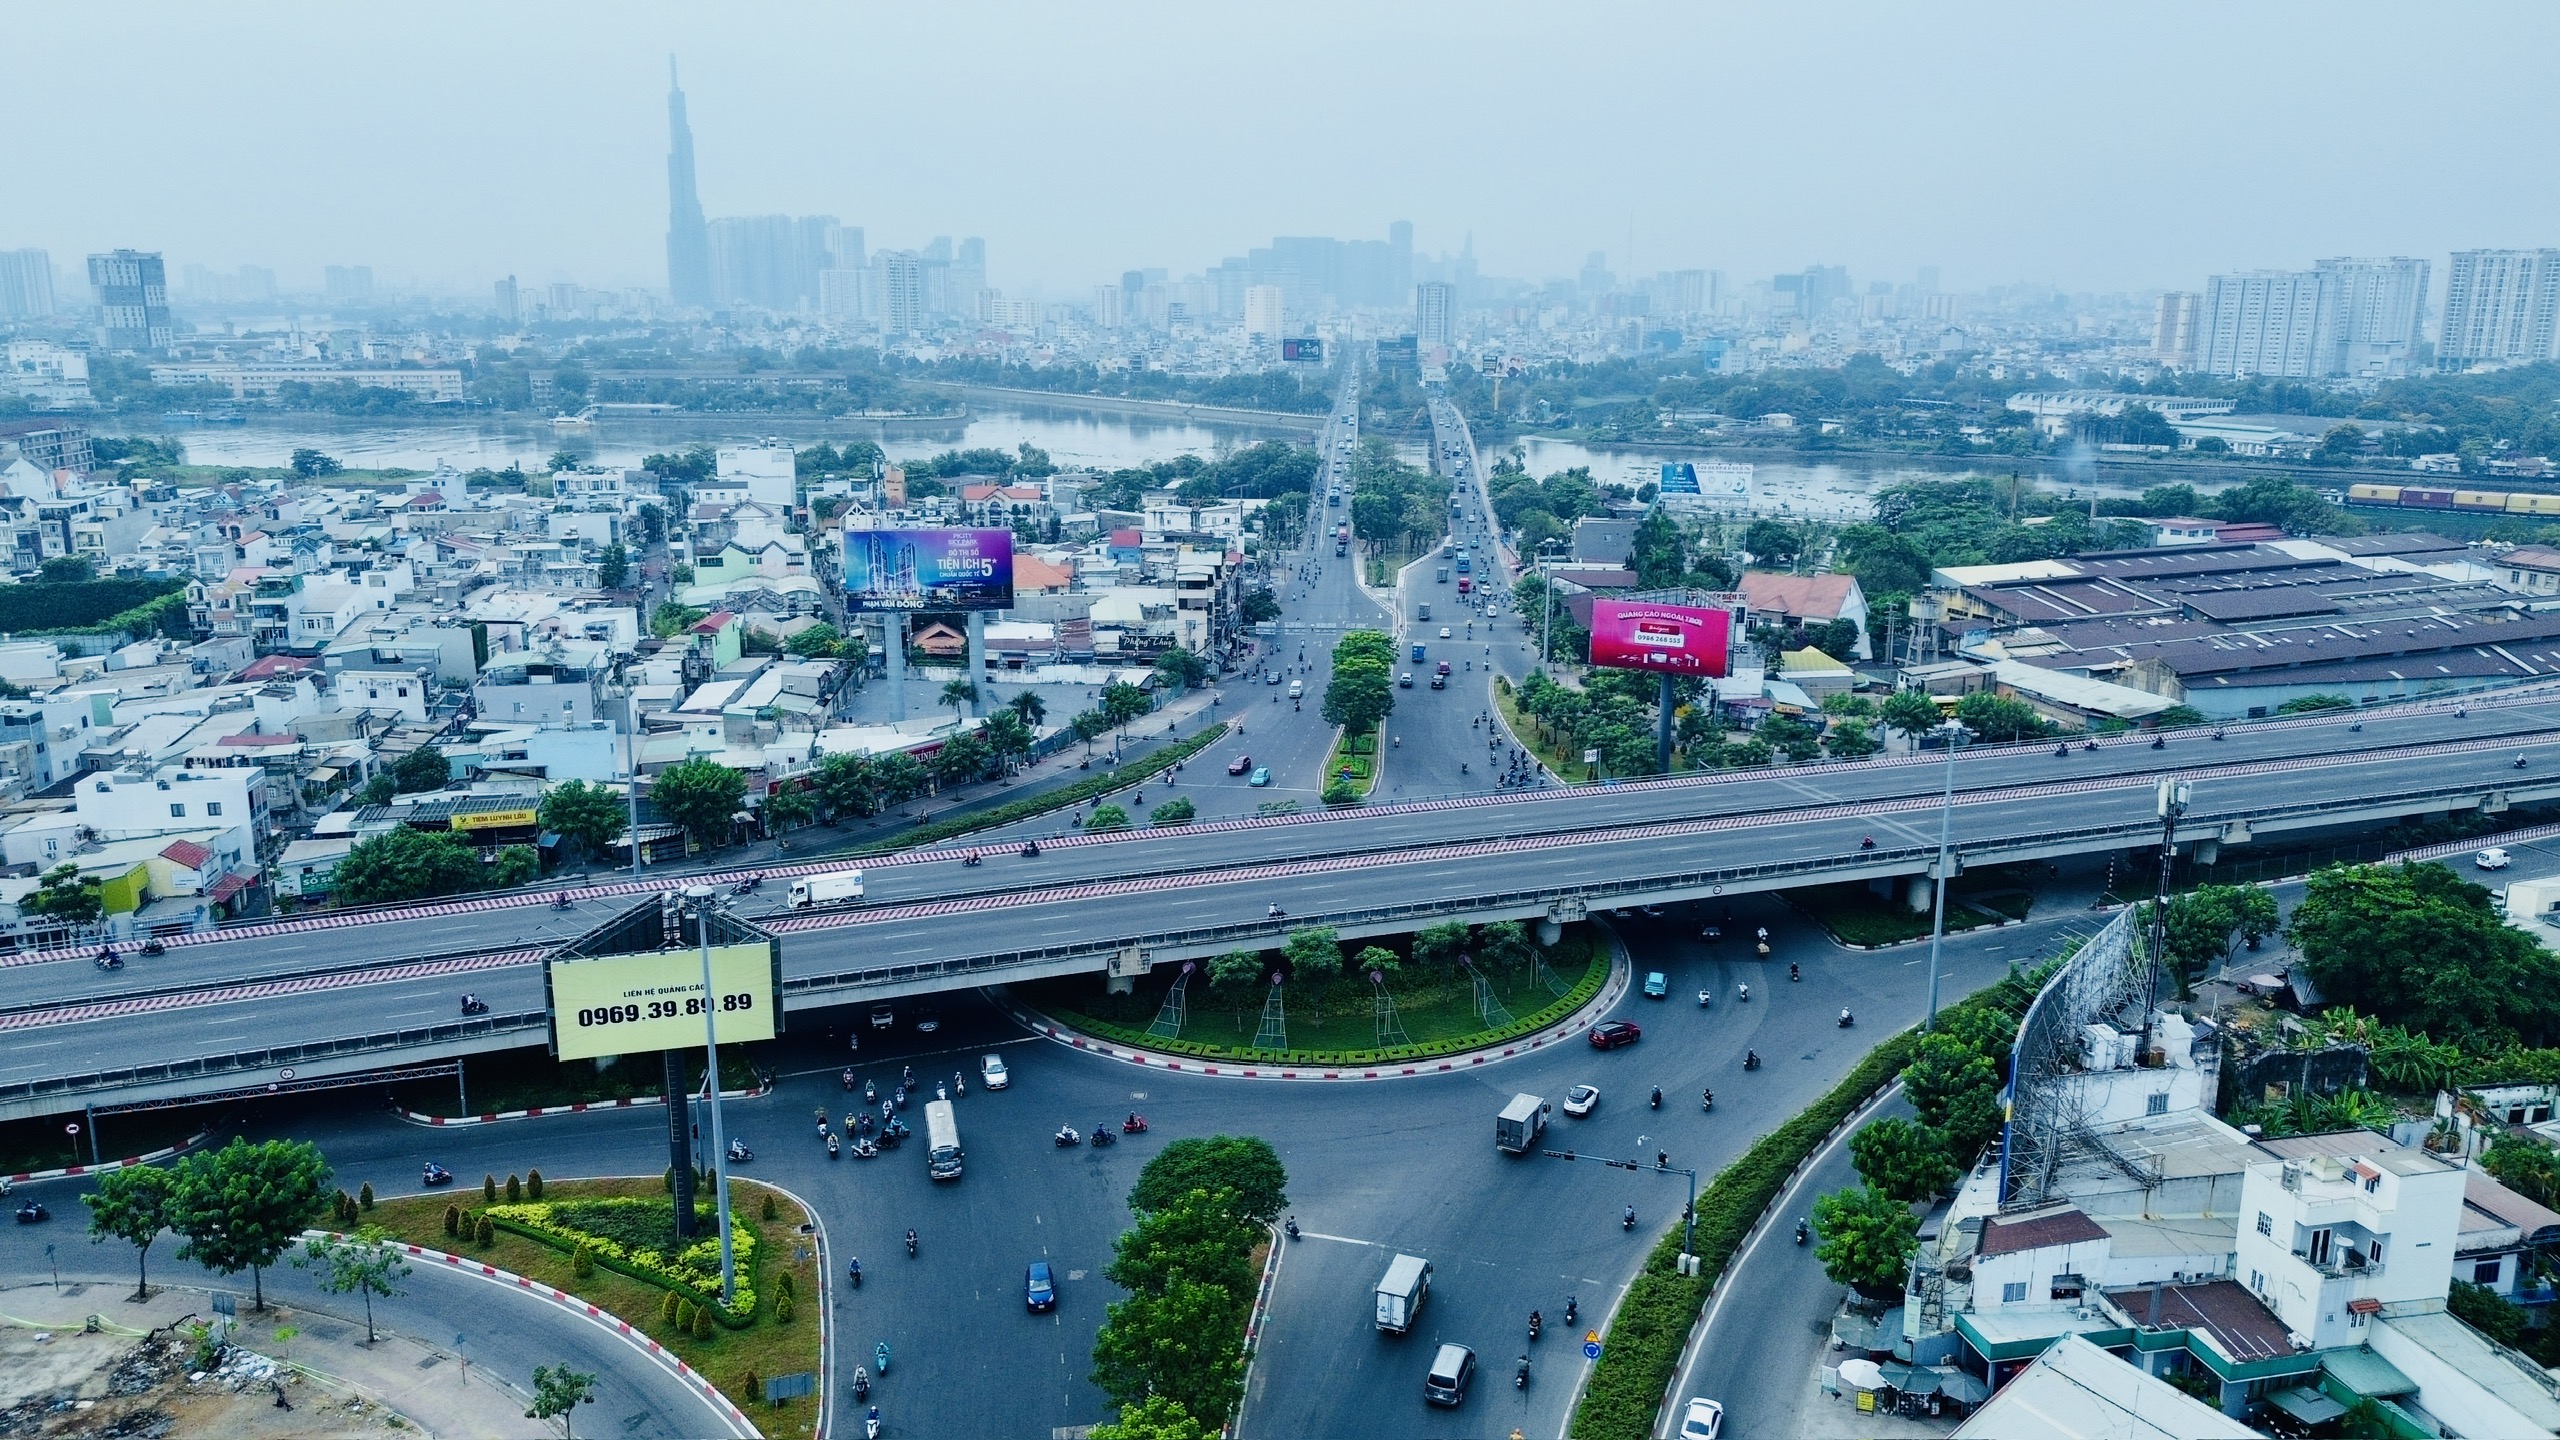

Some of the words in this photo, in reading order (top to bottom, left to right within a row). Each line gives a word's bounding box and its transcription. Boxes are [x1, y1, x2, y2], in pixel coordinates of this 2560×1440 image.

[970, 548, 980, 556] SỐ
[937, 557, 960, 570] TIỆN
[962, 556, 980, 570] ÍCH
[862, 601, 880, 609] PHẠM
[882, 600, 896, 608] VĂN
[896, 598, 924, 608] ĐỒNG
[1644, 610, 1660, 618] CÁO
[623, 989, 642, 997] LIÊN
[645, 988, 655, 996] HỆ
[658, 985, 686, 994] QUẢNG
